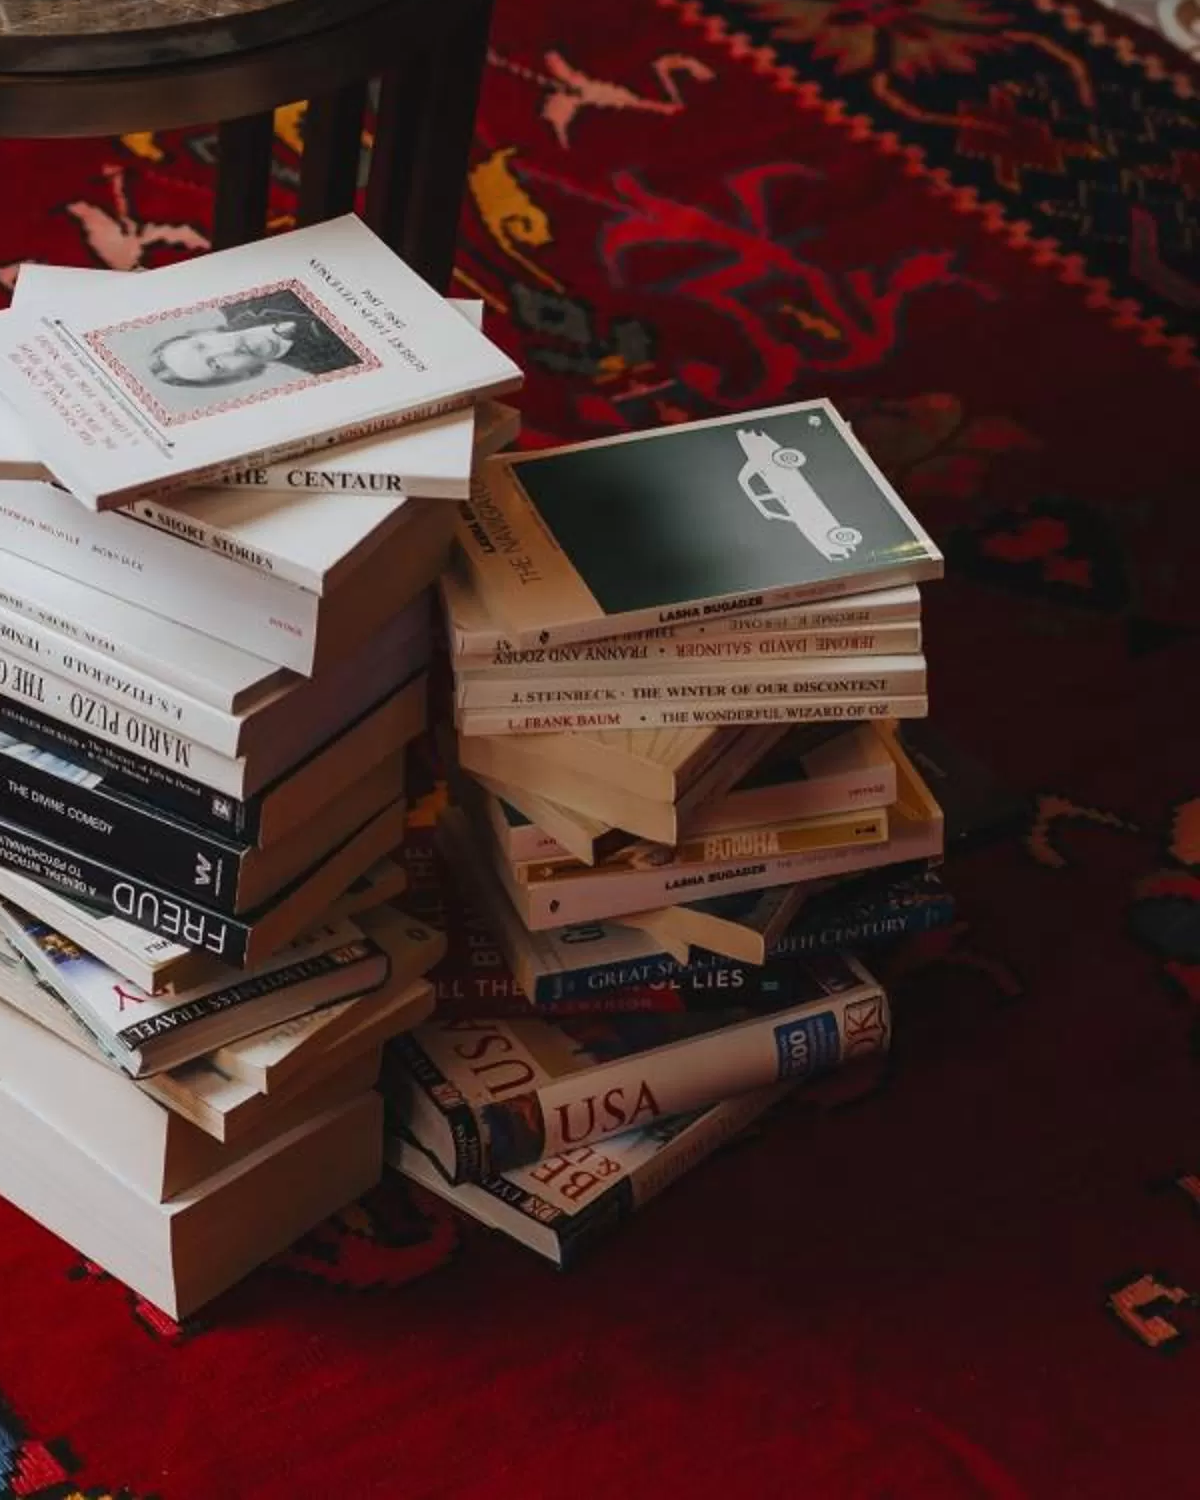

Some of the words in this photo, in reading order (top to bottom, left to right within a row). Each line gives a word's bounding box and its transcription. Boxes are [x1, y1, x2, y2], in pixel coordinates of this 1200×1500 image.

[287, 469, 403, 492] CENTAUR
[157, 511, 206, 542] SHORT
[211, 534, 274, 571] STORIES
[508, 555, 543, 586] THE
[659, 606, 700, 622] LASHA
[548, 647, 581, 662] AND
[584, 644, 649, 661] FRANNY
[676, 641, 754, 658] SALINGER
[758, 638, 809, 654] DAVID
[814, 635, 876, 651] JEROME
[11, 663, 46, 704] THE
[62, 654, 154, 706] FITZGERALD
[526, 688, 618, 703] STEINBECK
[632, 687, 662, 700] THE
[666, 681, 727, 697] WINTER
[731, 680, 752, 695] OF
[755, 681, 790, 695] OUR
[792, 678, 890, 694] DISCONTENT
[69, 691, 122, 737] PUZO
[524, 715, 575, 730] FRANK
[576, 712, 622, 727] BAUM
[661, 711, 690, 724] THE
[693, 707, 785, 723] WONDERFUL
[785, 703, 845, 719] WIZARD
[846, 703, 867, 717] OF
[868, 702, 890, 716] OZ
[126, 716, 194, 770] MARIO
[7, 779, 30, 800] THE
[31, 789, 66, 816] DIVINE
[67, 806, 113, 836] COMEDY
[44, 867, 87, 895] GENERAL
[664, 875, 706, 892] LASHA
[112, 882, 227, 955] FREUD
[819, 915, 909, 946] CENTURY
[587, 966, 650, 991] GREAT
[692, 968, 746, 990] LIES
[128, 1006, 204, 1044] TRAVEL
[553, 1080, 661, 1143] USA
